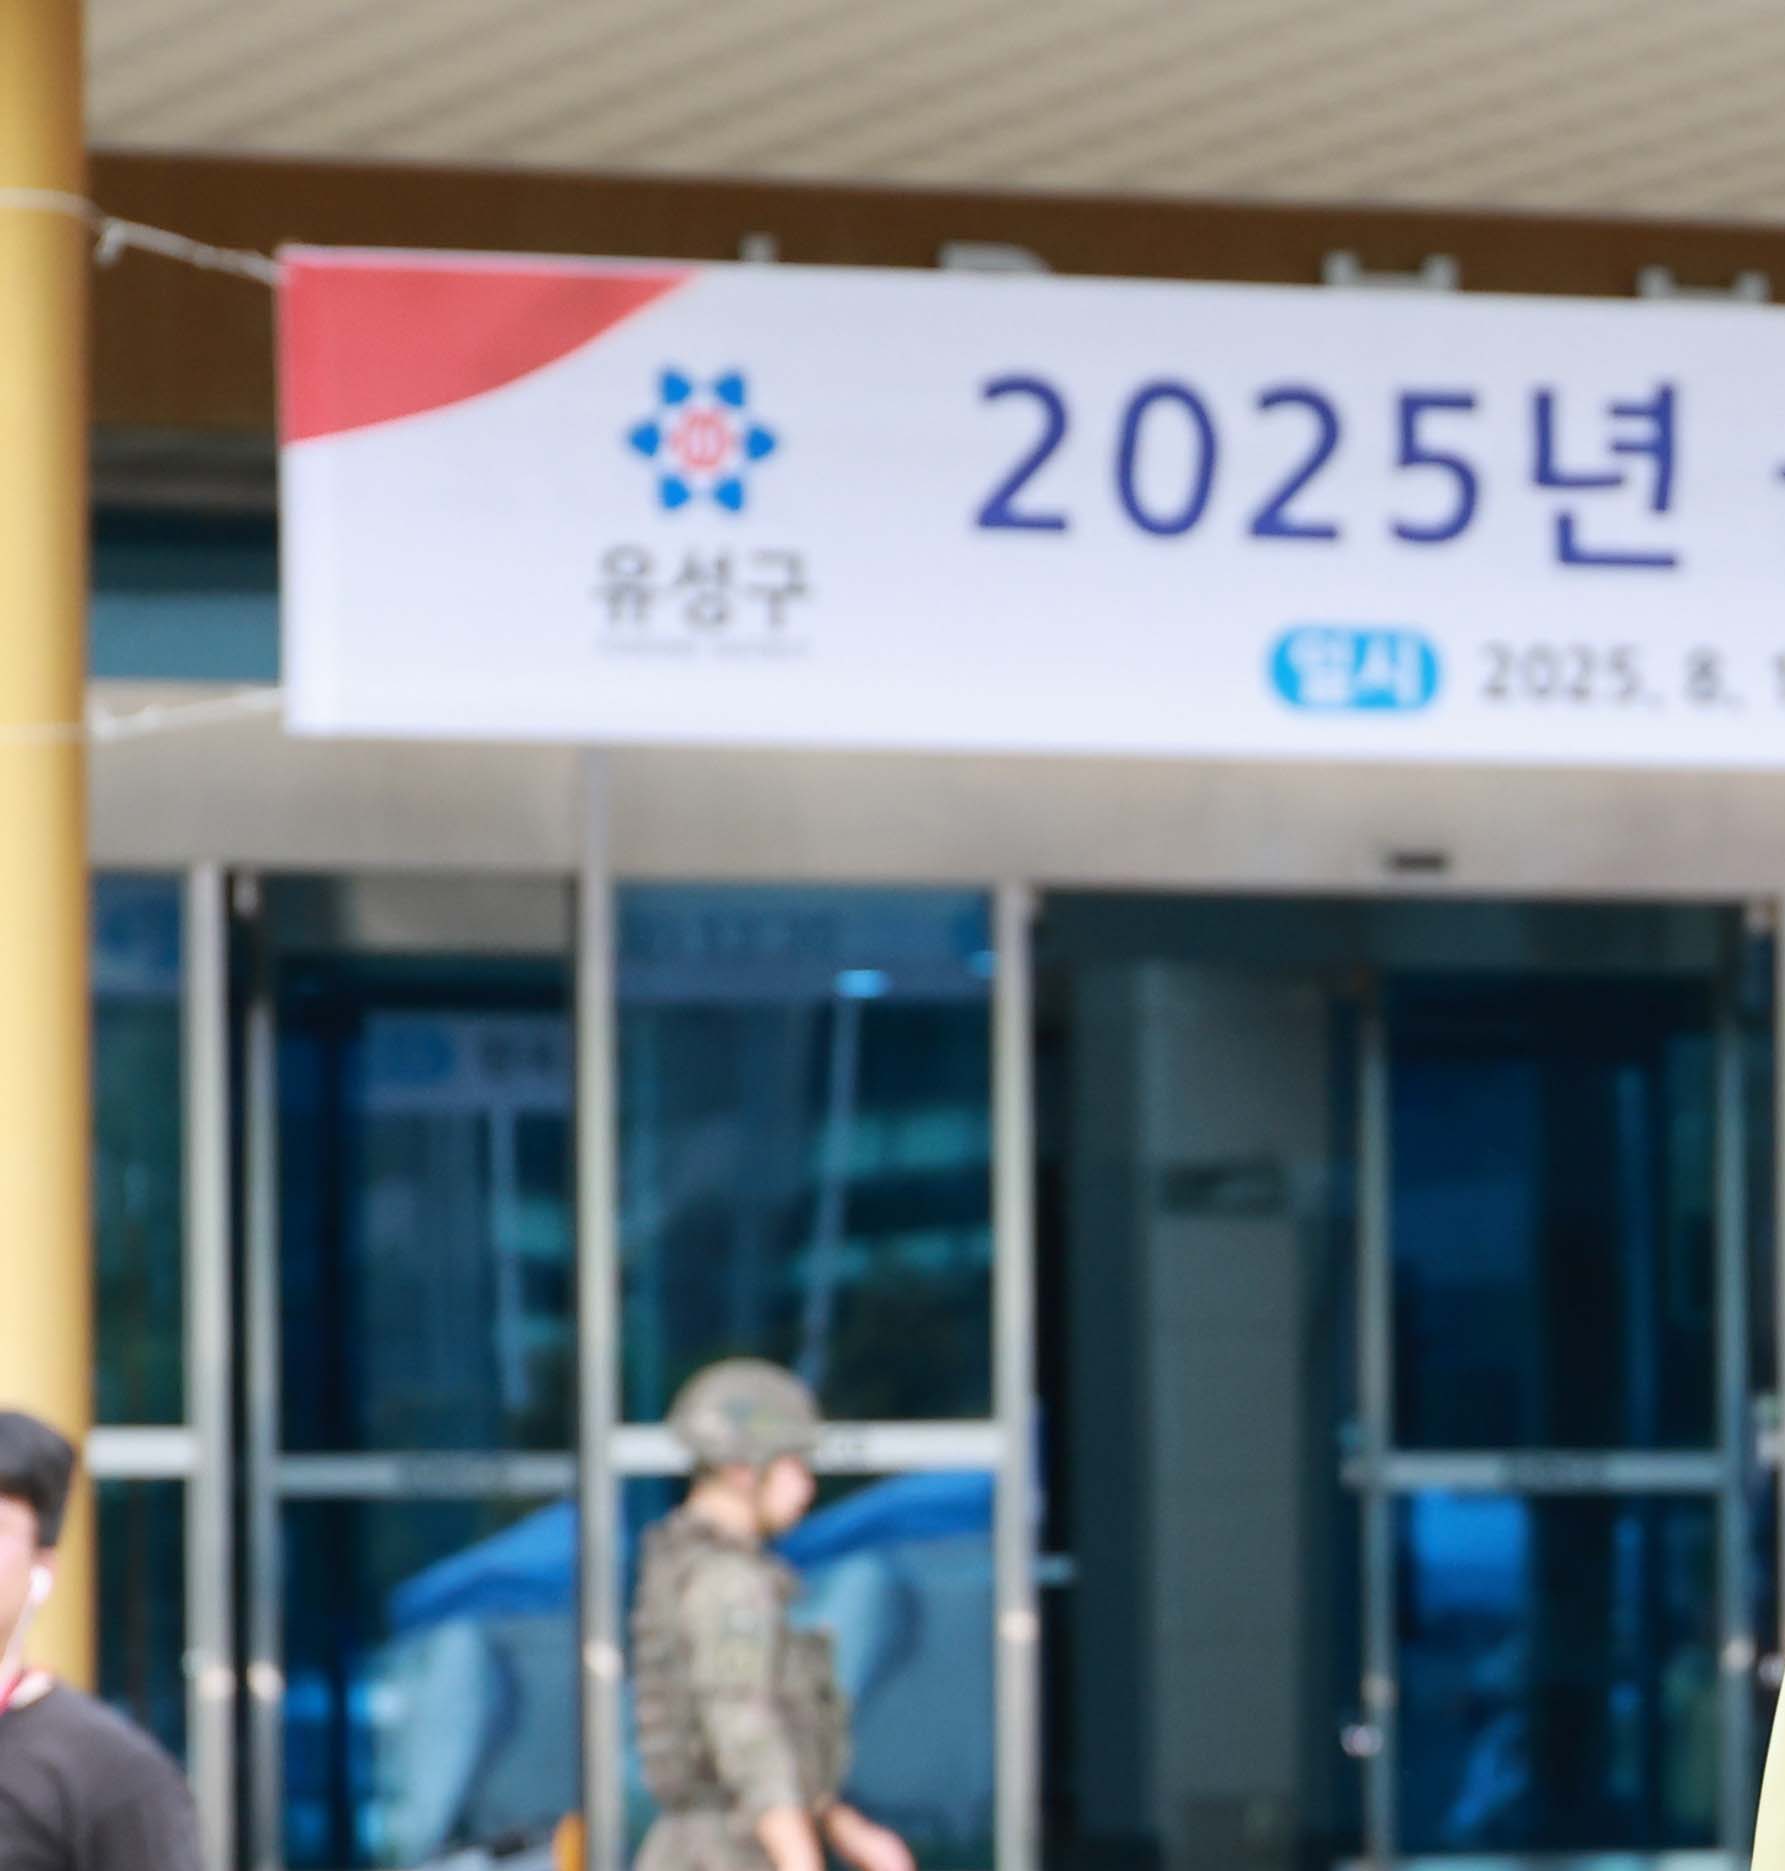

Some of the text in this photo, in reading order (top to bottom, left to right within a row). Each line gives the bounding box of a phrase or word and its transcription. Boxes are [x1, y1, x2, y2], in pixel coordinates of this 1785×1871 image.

[972, 372, 1682, 573] 2025년
[596, 545, 812, 630] 유성구
[1288, 630, 1424, 709] 일시
